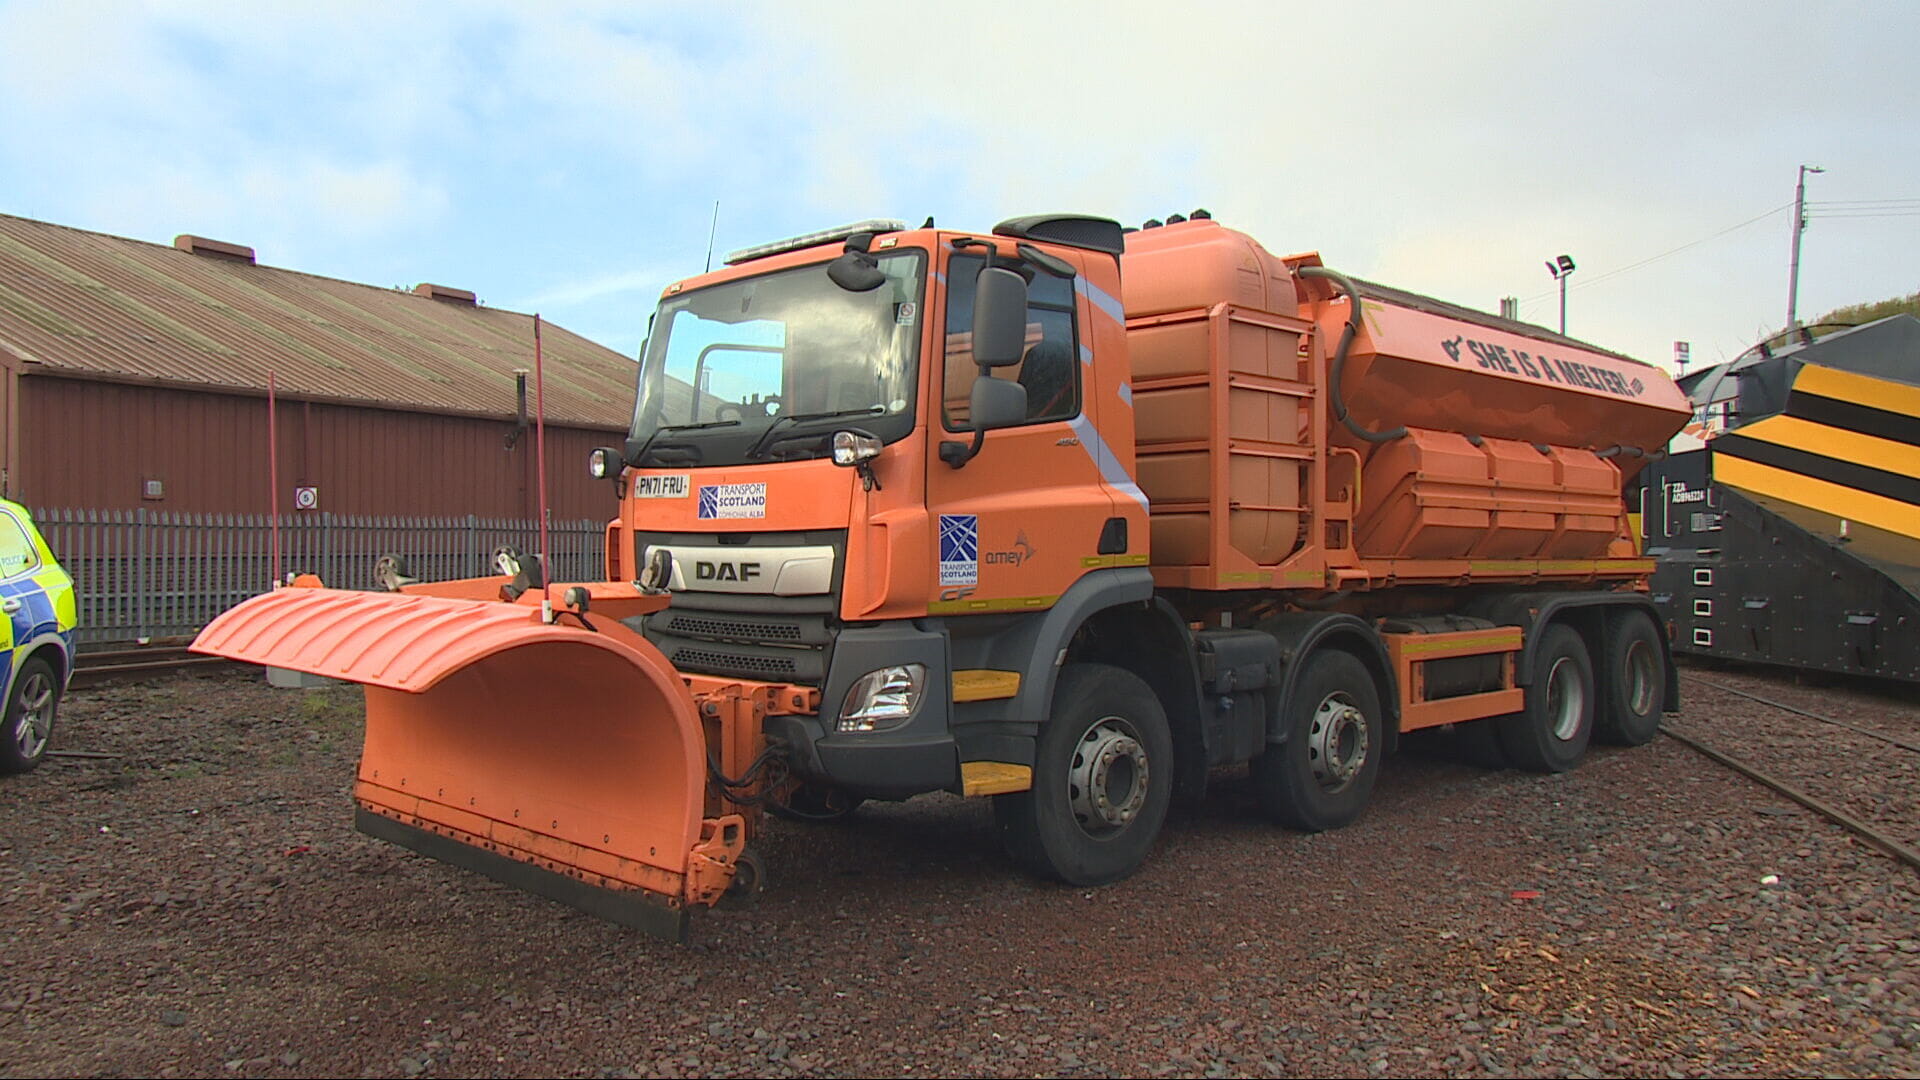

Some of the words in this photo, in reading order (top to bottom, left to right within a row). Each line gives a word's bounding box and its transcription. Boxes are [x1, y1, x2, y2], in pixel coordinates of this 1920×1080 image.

[1466, 339, 1519, 374] SHE
[1512, 349, 1542, 378] IS
[1537, 355, 1562, 383] A
[1553, 359, 1635, 397] MELTER!
[640, 477, 661, 494] PN71
[662, 476, 683, 494] FRU
[720, 484, 765, 496] TRANSPORT
[303, 494, 309, 502] 5
[719, 496, 765, 506] SCOTLAND
[985, 551, 1023, 568] amey
[696, 561, 760, 582] DAF
[941, 563, 976, 571] TRANSPORT
